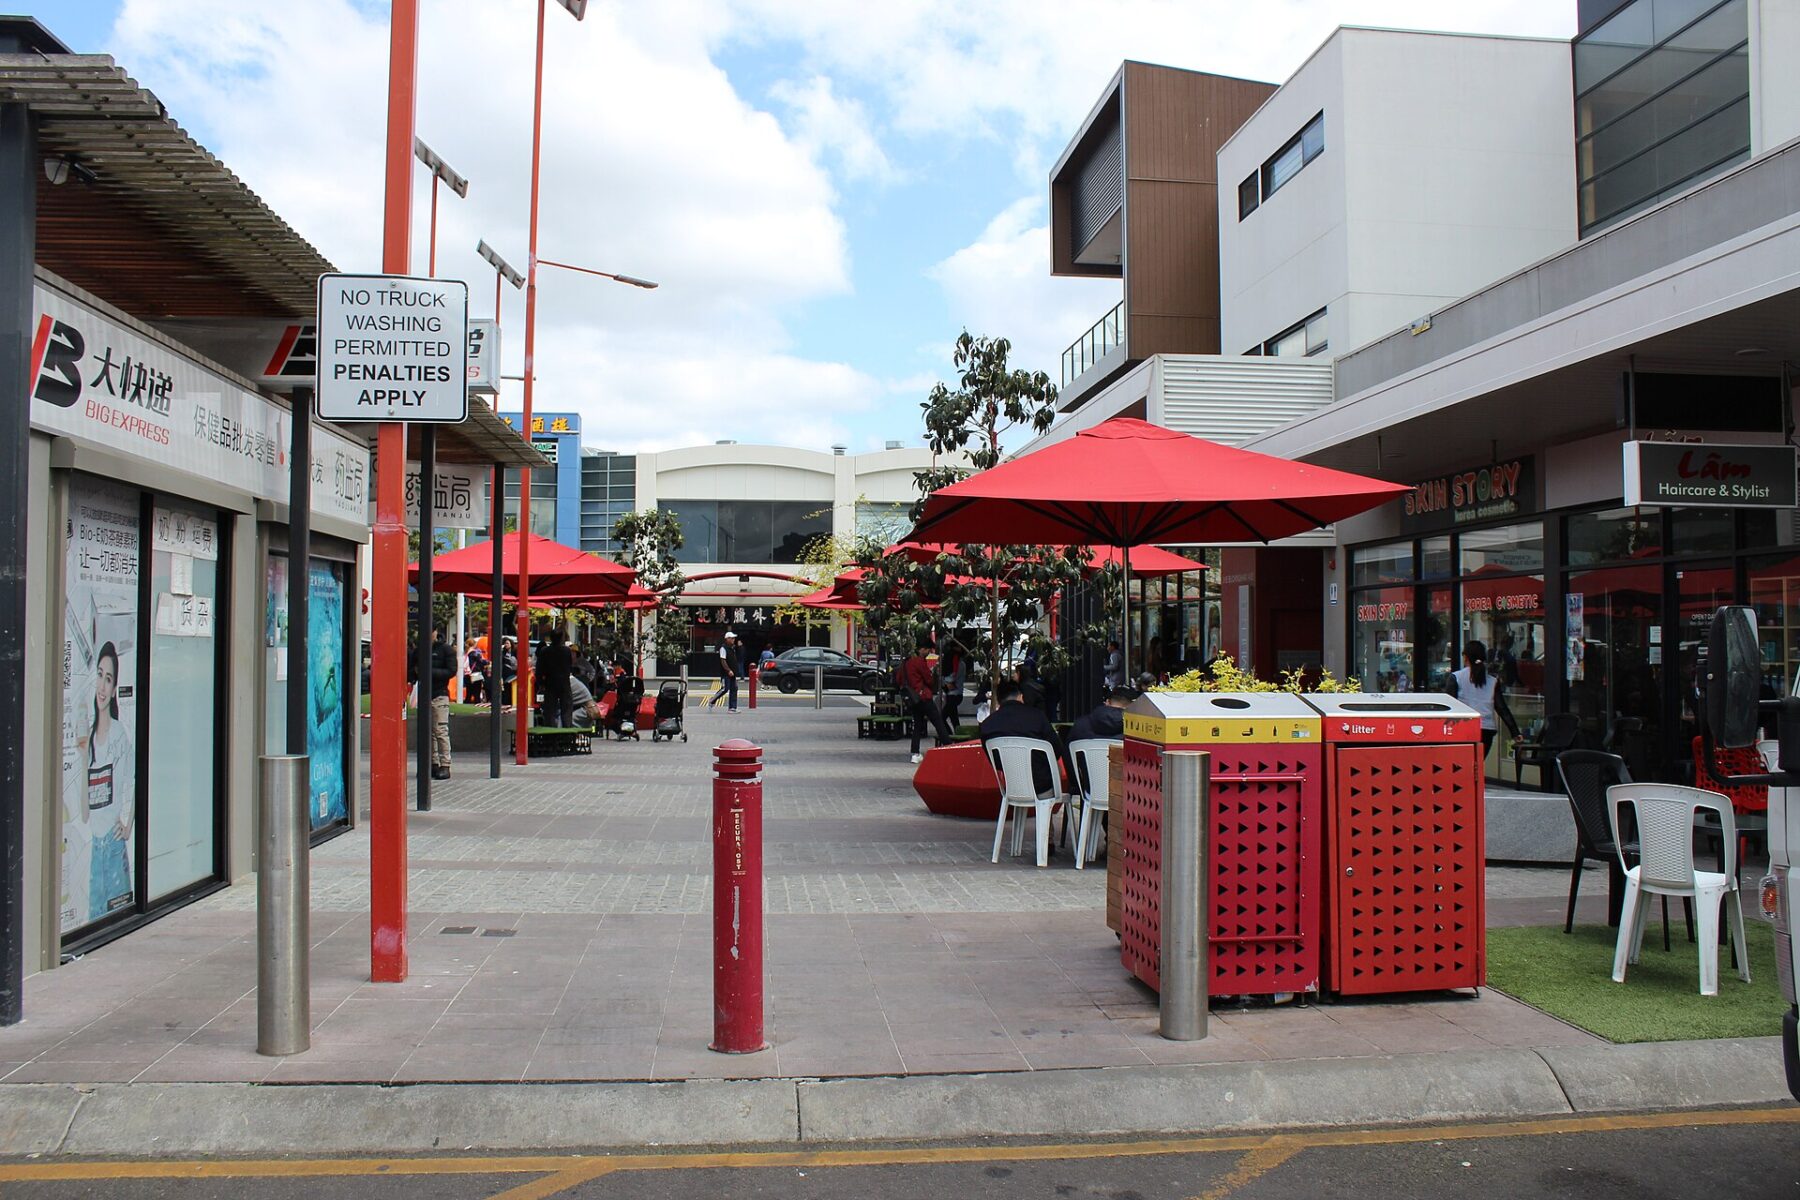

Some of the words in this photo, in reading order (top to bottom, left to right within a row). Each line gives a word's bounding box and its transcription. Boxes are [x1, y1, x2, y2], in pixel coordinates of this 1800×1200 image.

[341, 289, 371, 306] NO
[376, 290, 446, 308] TRUCK
[346, 314, 442, 333] WASHING
[334, 339, 451, 357] PERMITTED
[89, 346, 173, 418] 大快递
[333, 364, 451, 383] PENALTIES
[357, 389, 427, 407] APPLY
[85, 399, 110, 424] BIG
[111, 409, 170, 445] EXPRESS
[1404, 478, 1448, 516] SKIN
[1452, 461, 1520, 508] STORY
[1658, 482, 1717, 497] Haircare
[1718, 484, 1730, 497] &
[1731, 484, 1771, 501] Stylist
[406, 509, 472, 520] YAIANJU
[79, 546, 138, 576] 让一切都消失
[1357, 604, 1378, 622] SKIN
[1378, 602, 1408, 622] STORY
[1465, 597, 1493, 612] KOREA
[1352, 724, 1376, 734] litter
[734, 812, 742, 870] SECURAOST
